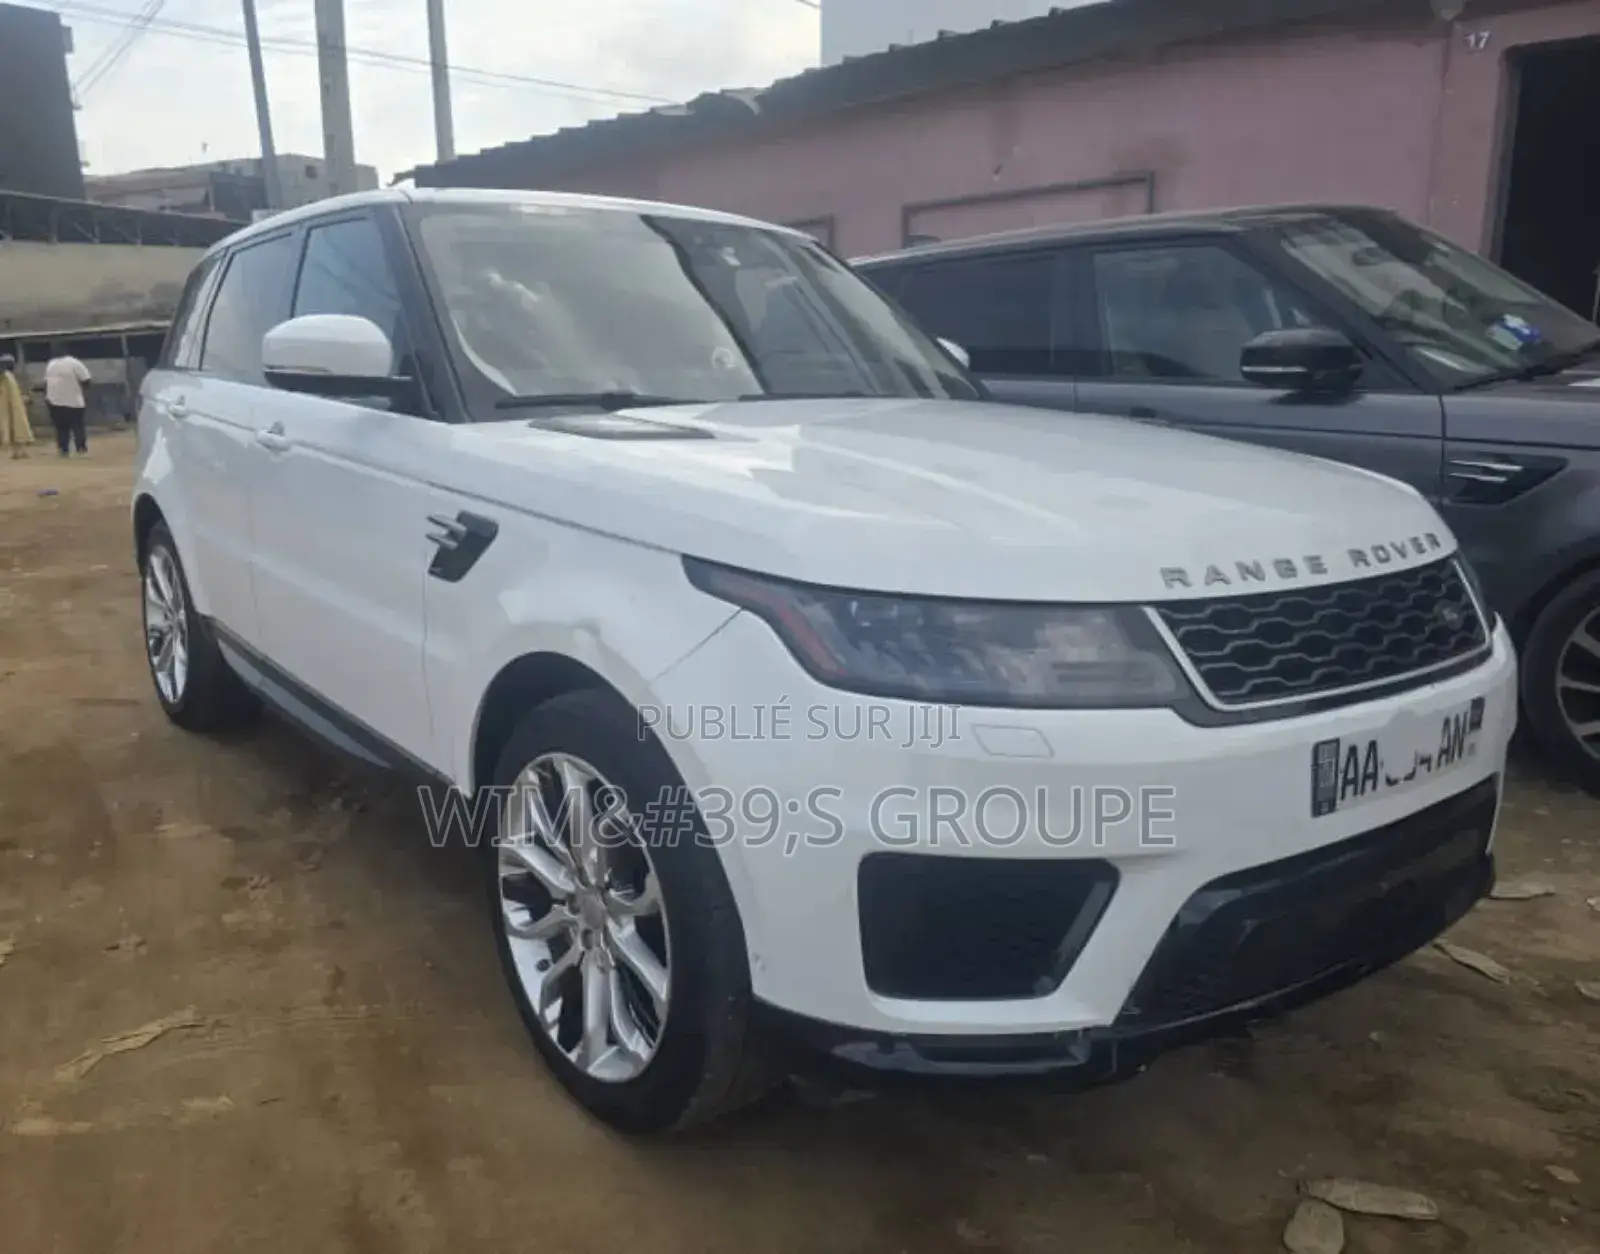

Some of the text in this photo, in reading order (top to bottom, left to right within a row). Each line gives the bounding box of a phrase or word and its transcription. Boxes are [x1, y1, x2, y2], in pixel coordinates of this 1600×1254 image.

[1464, 30, 1490, 49] 17
[1159, 532, 1441, 589] RANGE ROVER
